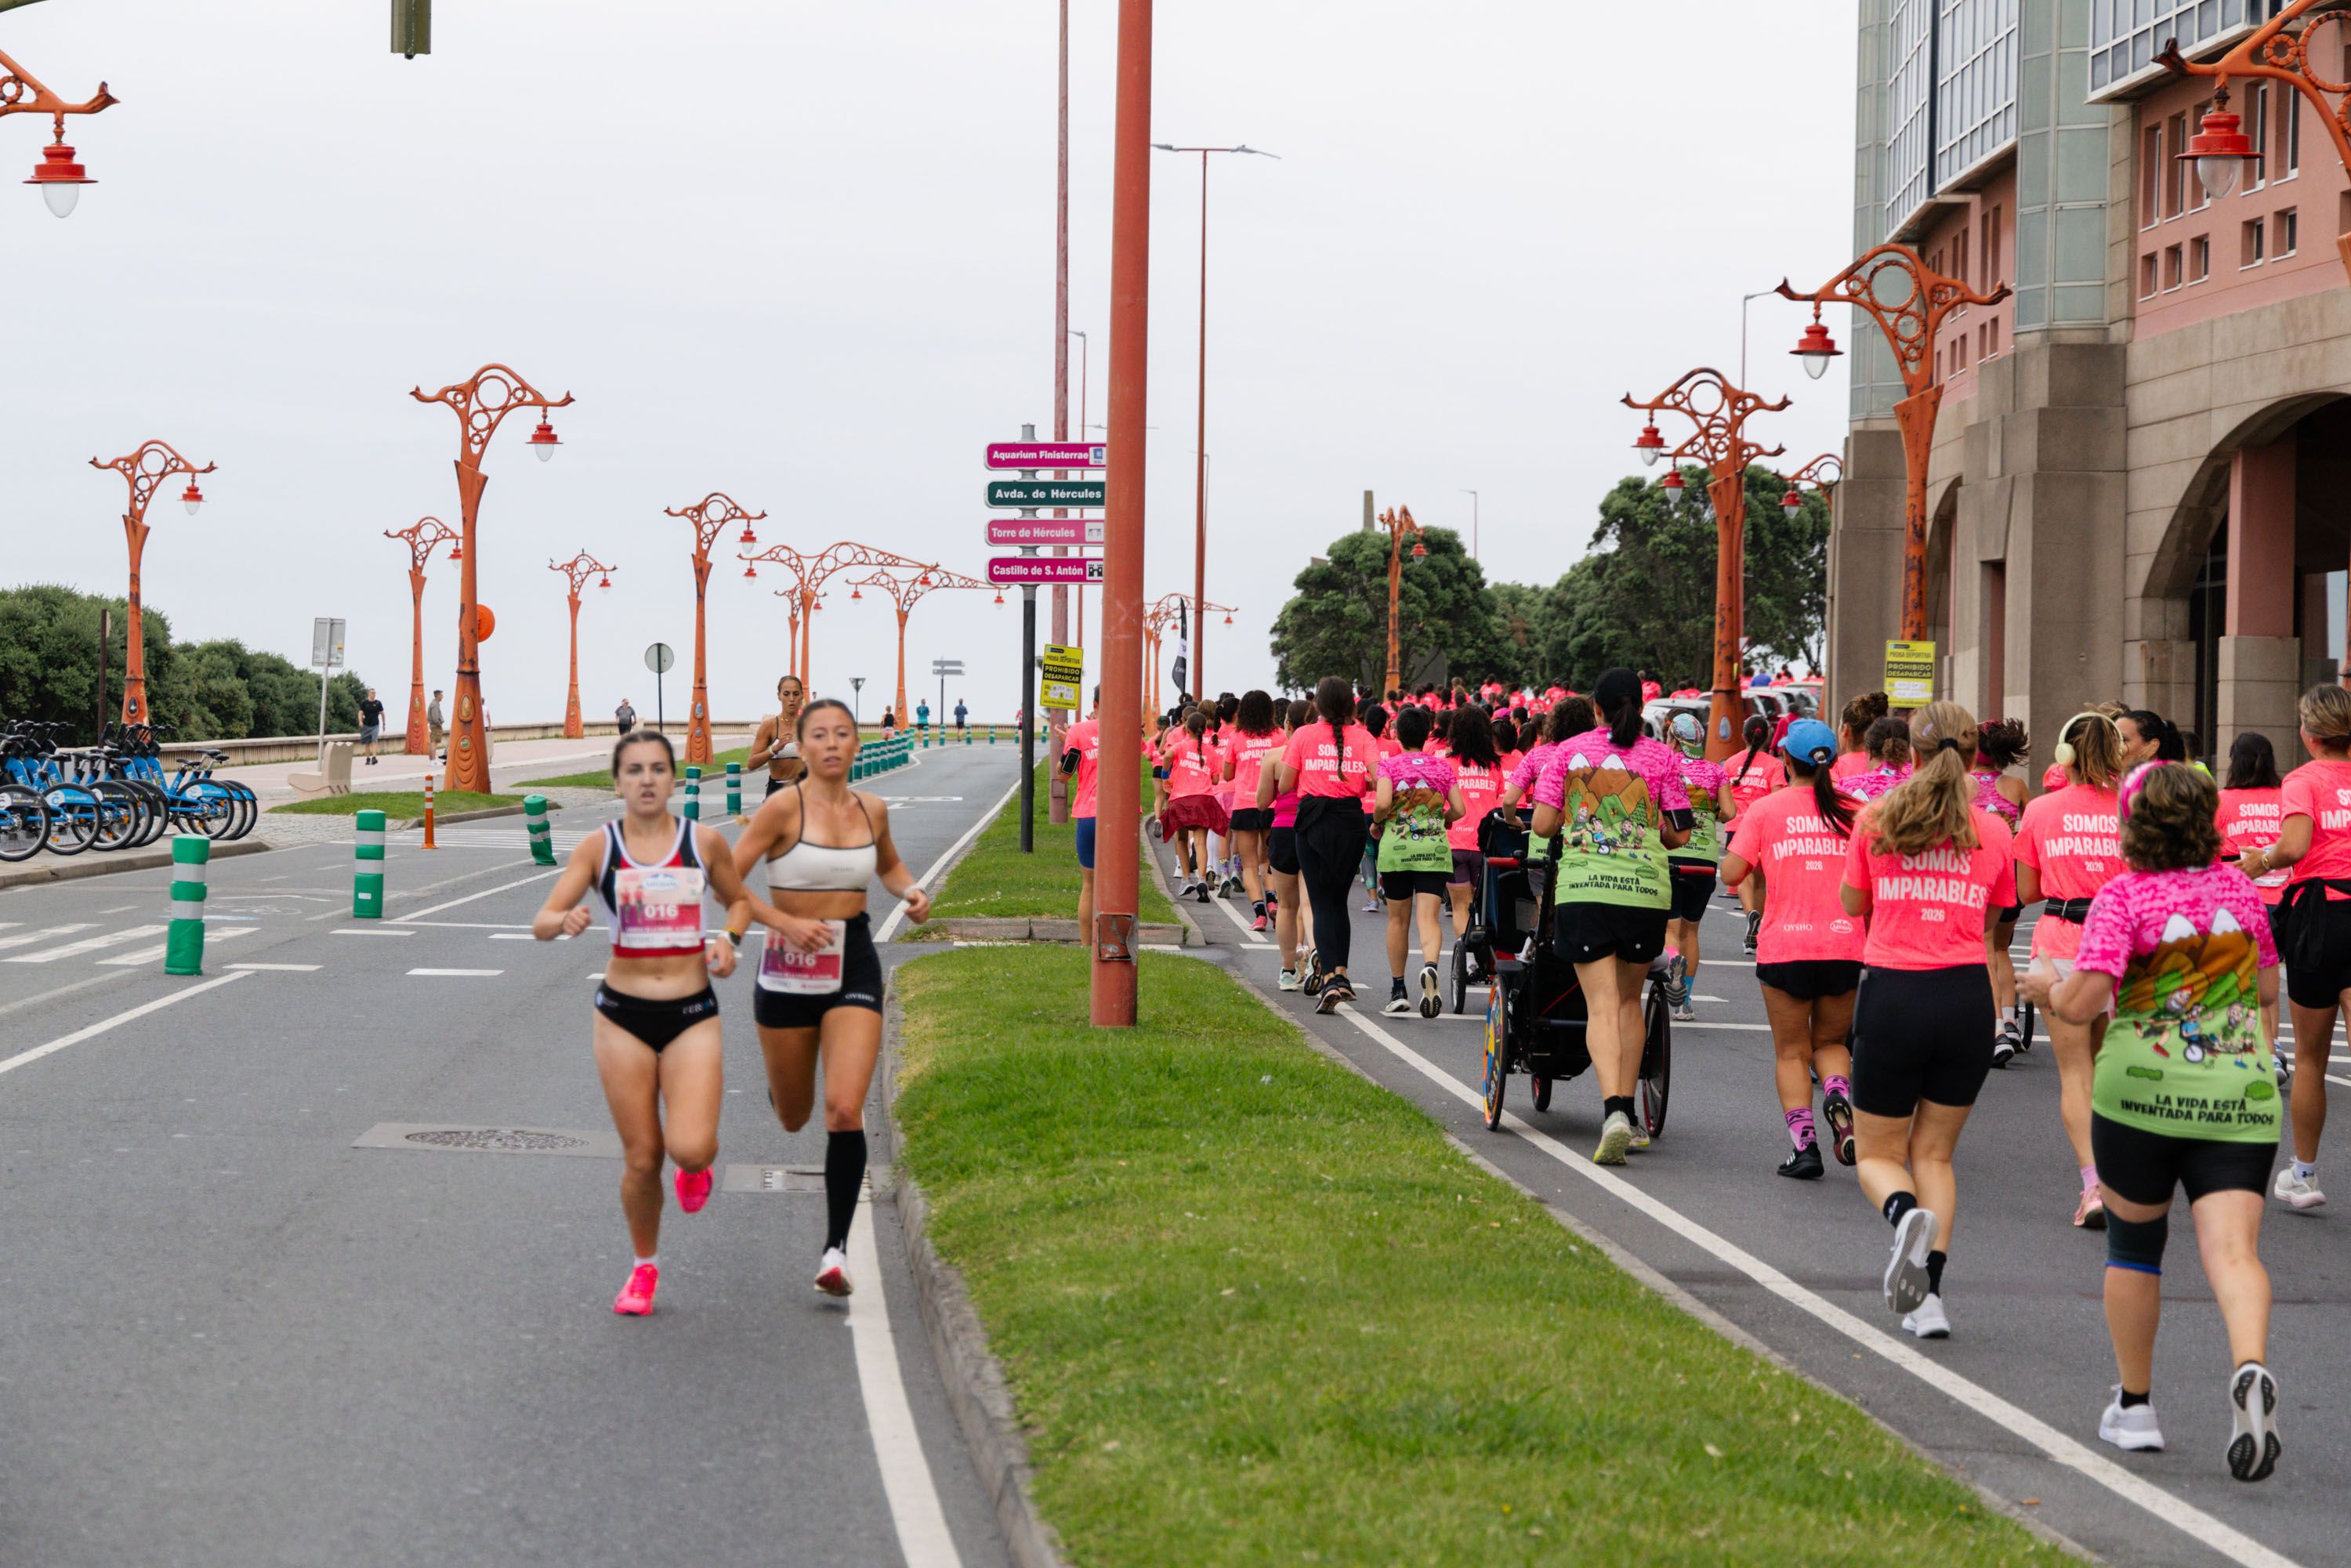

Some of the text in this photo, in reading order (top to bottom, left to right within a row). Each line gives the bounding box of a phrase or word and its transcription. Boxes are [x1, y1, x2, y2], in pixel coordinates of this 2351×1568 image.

[993, 451, 1089, 461] Aquarium Finisterrae
[995, 488, 1102, 498] Avda. de Hércules
[991, 527, 1075, 538] Torre de Hércules
[993, 565, 1083, 575] Castillo de S. Antón
[1045, 665, 1080, 675] PROHIBIDO
[1317, 744, 1353, 759] SOMS
[2238, 803, 2280, 817] SOMOS
[2063, 813, 2118, 834] SOMOS
[2226, 819, 2282, 837] IMPARABL
[1773, 838, 1849, 861] IMPARABLE
[1805, 860, 1823, 871] 2026
[2085, 860, 2104, 872] 2026
[1600, 875, 1619, 883] VIDA
[1569, 881, 1658, 896] INVENTADA PARA TODOS
[1878, 876, 1987, 910] IMPARABLES
[644, 904, 679, 919] 016
[1921, 908, 1945, 922] 2026
[1784, 923, 1813, 932] OYSHO
[784, 953, 817, 966] 016
[2156, 1094, 2172, 1106] LA
[2177, 1097, 2208, 1109] VIDA
[2121, 1099, 2274, 1124] INVENTADA PARA TODOS
